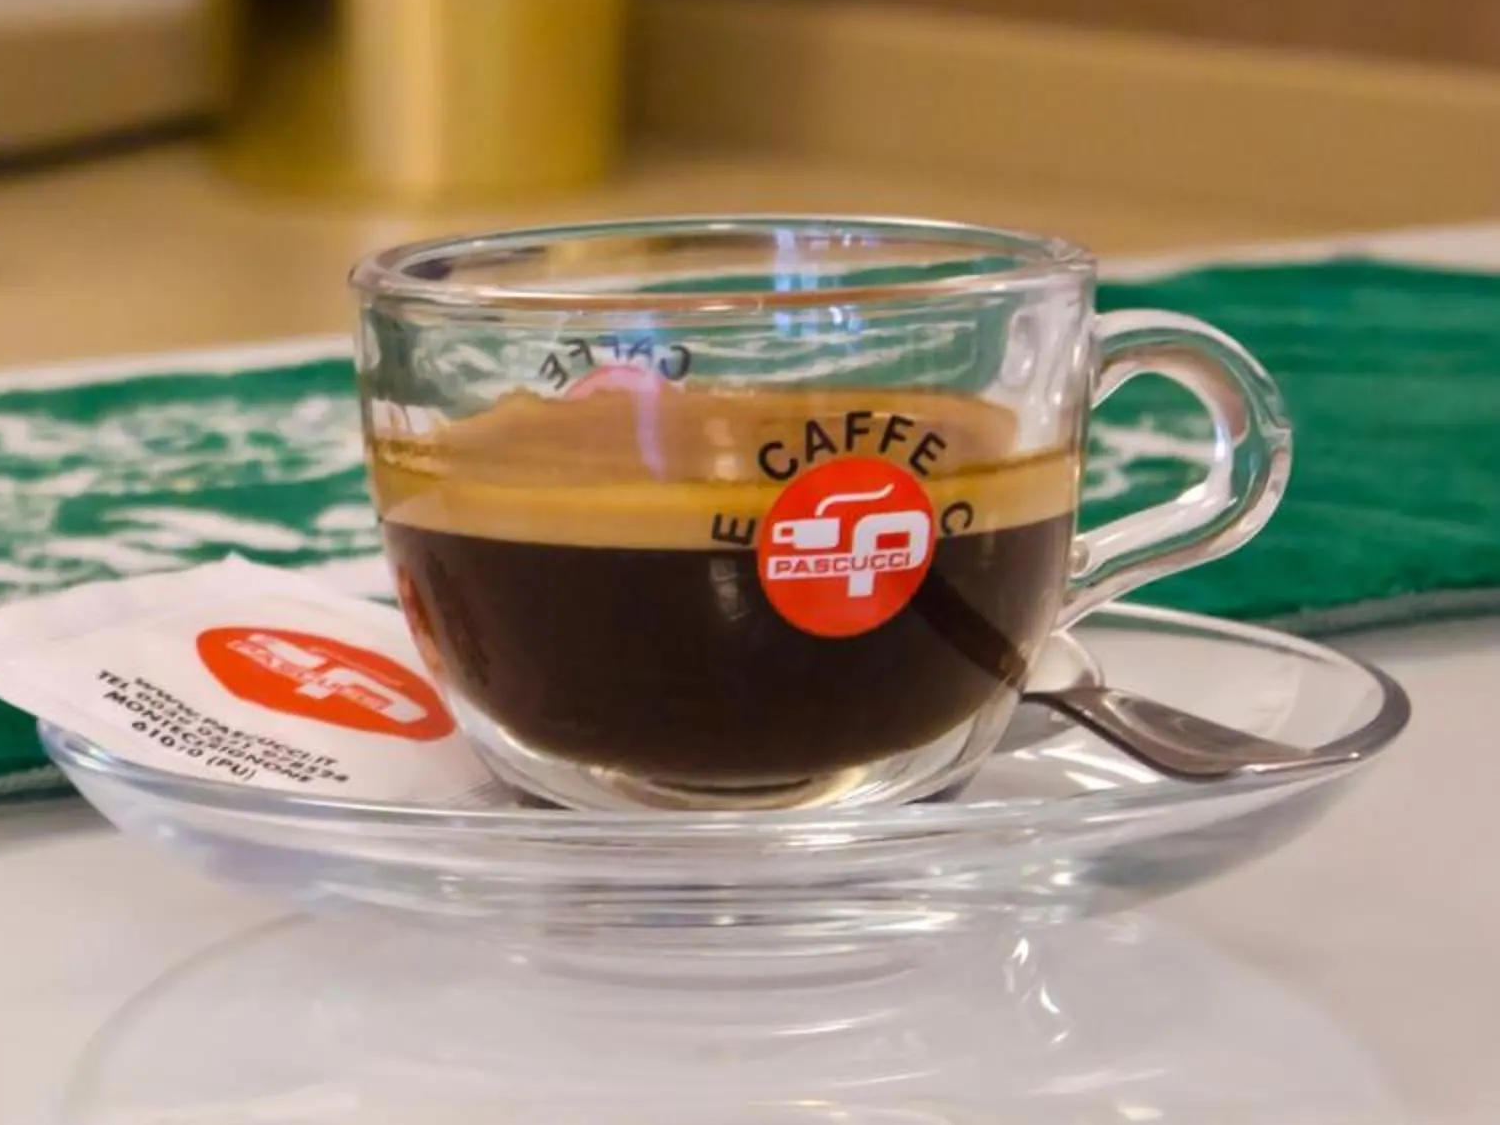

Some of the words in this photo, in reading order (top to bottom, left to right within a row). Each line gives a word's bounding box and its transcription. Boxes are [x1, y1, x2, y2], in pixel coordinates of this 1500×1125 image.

[757, 410, 947, 481] CAFFE
[772, 551, 912, 575] PASCUCCI
[97, 669, 130, 690] TEL
[205, 755, 258, 782] (PU)
